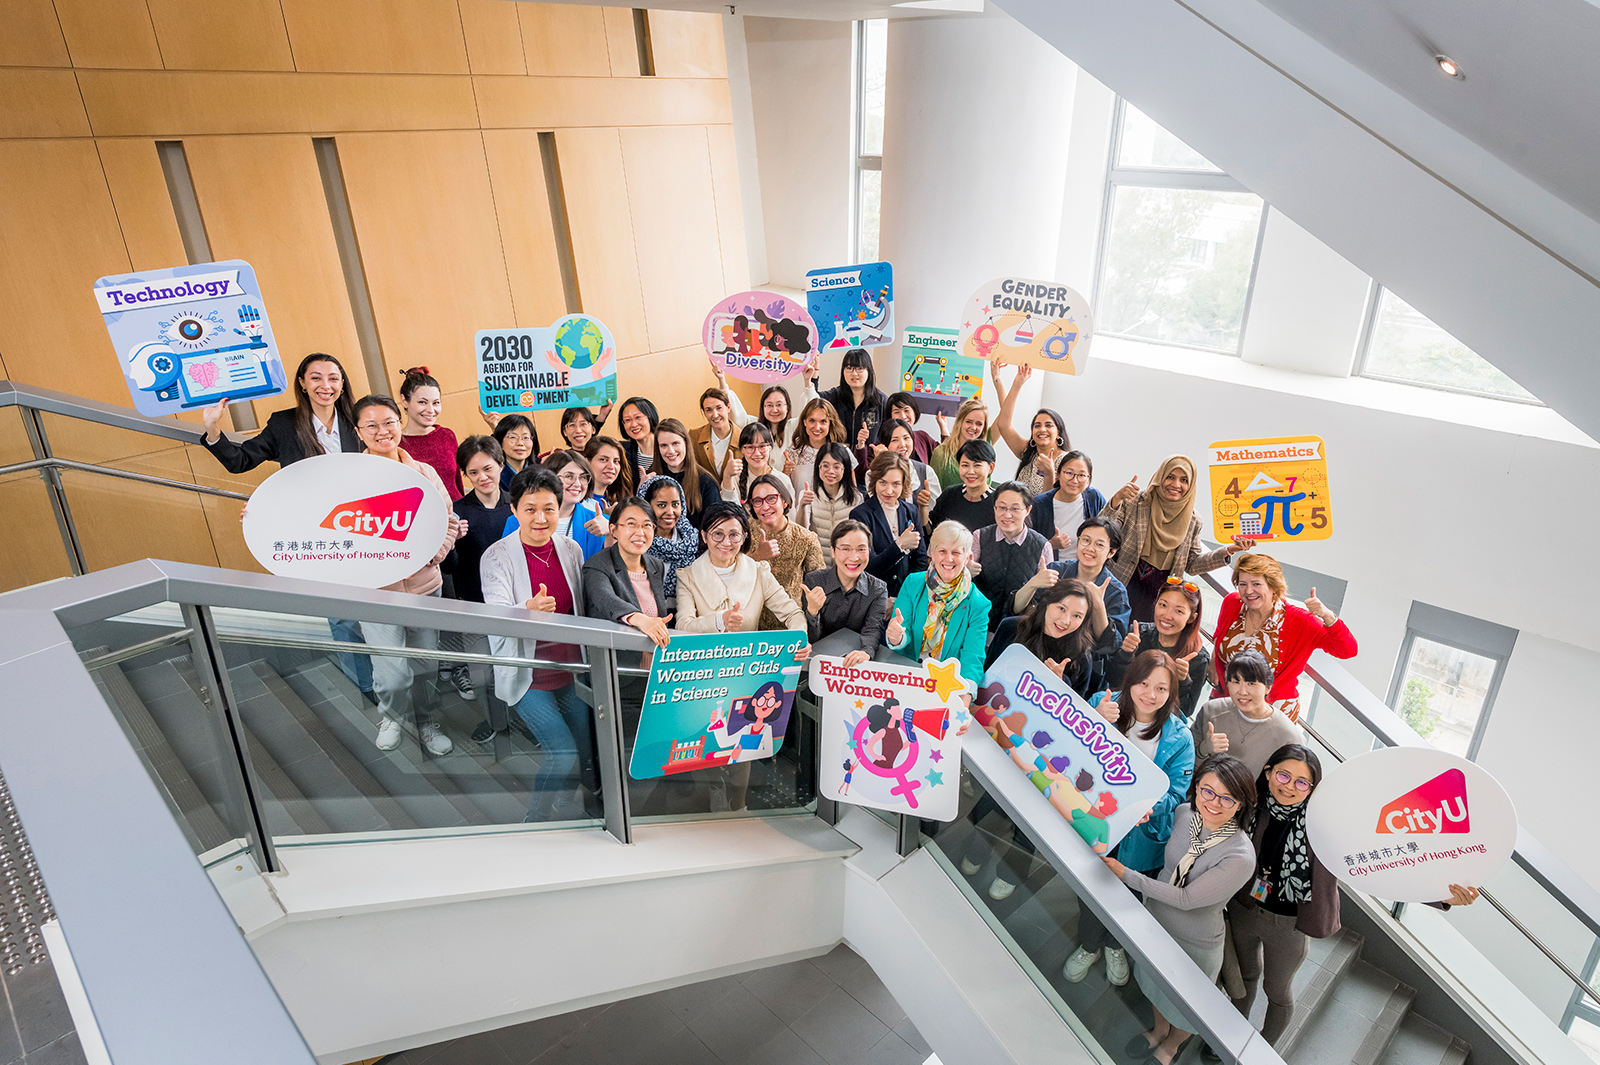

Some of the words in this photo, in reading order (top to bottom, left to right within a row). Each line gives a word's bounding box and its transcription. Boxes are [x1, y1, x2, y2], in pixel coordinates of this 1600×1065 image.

[106, 280, 230, 306] Technology
[811, 276, 856, 288] Science
[1001, 279, 1067, 301] GENDER
[992, 294, 1071, 318] EQUALITY
[224, 354, 245, 363] BRAIN
[480, 335, 533, 361] 2030
[483, 362, 517, 374] AGENDA
[518, 361, 534, 372] FOR
[726, 352, 793, 374] Diversity
[484, 371, 569, 391] SUSTAINABLE
[1216, 446, 1314, 461] Mathematics
[1224, 477, 1242, 498] 4
[333, 510, 412, 538] CityU
[272, 540, 354, 551] 香港城市大學
[272, 552, 294, 563] City
[295, 551, 345, 562] University
[346, 550, 358, 559] of
[359, 551, 385, 560] Hong
[386, 550, 411, 559] Kong
[659, 643, 753, 663] International
[756, 642, 784, 658] Day
[787, 640, 802, 653] of
[656, 667, 713, 684] Women
[717, 663, 745, 678] and
[748, 660, 780, 675] Girls
[819, 660, 937, 693] Empowering
[650, 690, 667, 705] in
[671, 686, 728, 703] Science
[824, 677, 894, 699] Women
[1015, 670, 1137, 785] Inclusivity
[1385, 796, 1467, 834] CityU
[1344, 841, 1420, 867] 香港城市大學
[1348, 866, 1368, 877] City
[1368, 856, 1416, 873] University
[1417, 853, 1428, 863] of
[1429, 850, 1458, 862] Hong
[1457, 843, 1487, 856] Kong
